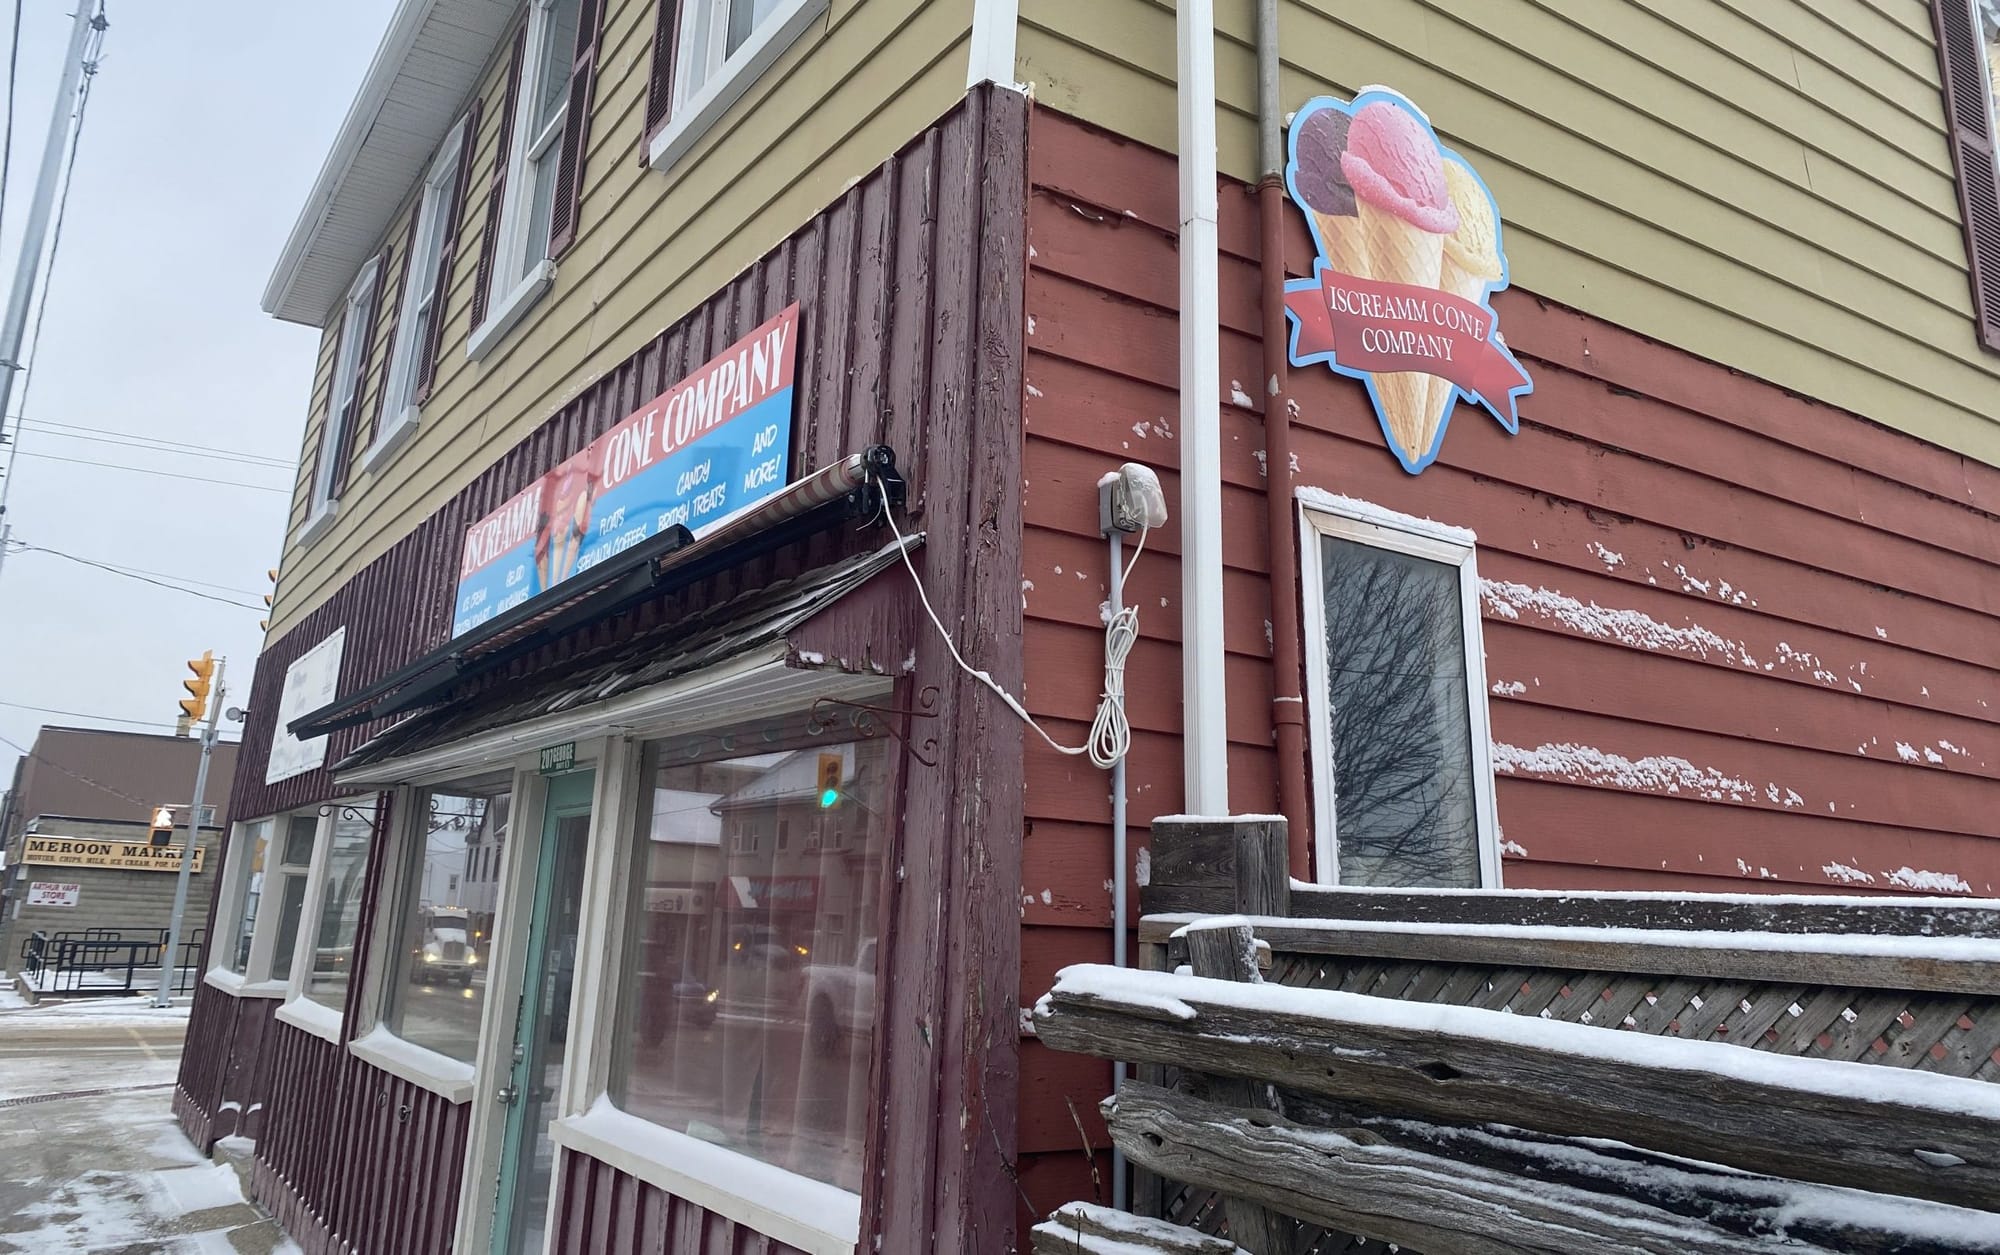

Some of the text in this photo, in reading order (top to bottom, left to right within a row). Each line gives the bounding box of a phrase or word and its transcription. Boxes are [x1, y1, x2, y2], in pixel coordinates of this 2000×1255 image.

[1329, 286, 1485, 342] ISCREAMM CONE
[1361, 327, 1454, 361] COMPANY
[463, 320, 791, 577] ISCREAMM CONE COMPANY
[752, 423, 778, 457] AND
[676, 458, 711, 497] CANDY
[744, 454, 781, 493] MORE!
[600, 505, 625, 536] FLOATS
[657, 481, 726, 532] BRITISH TREATS
[29, 841, 112, 855] MEROON
[32, 883, 60, 891] ARTHUR
[41, 891, 66, 899] STORE
